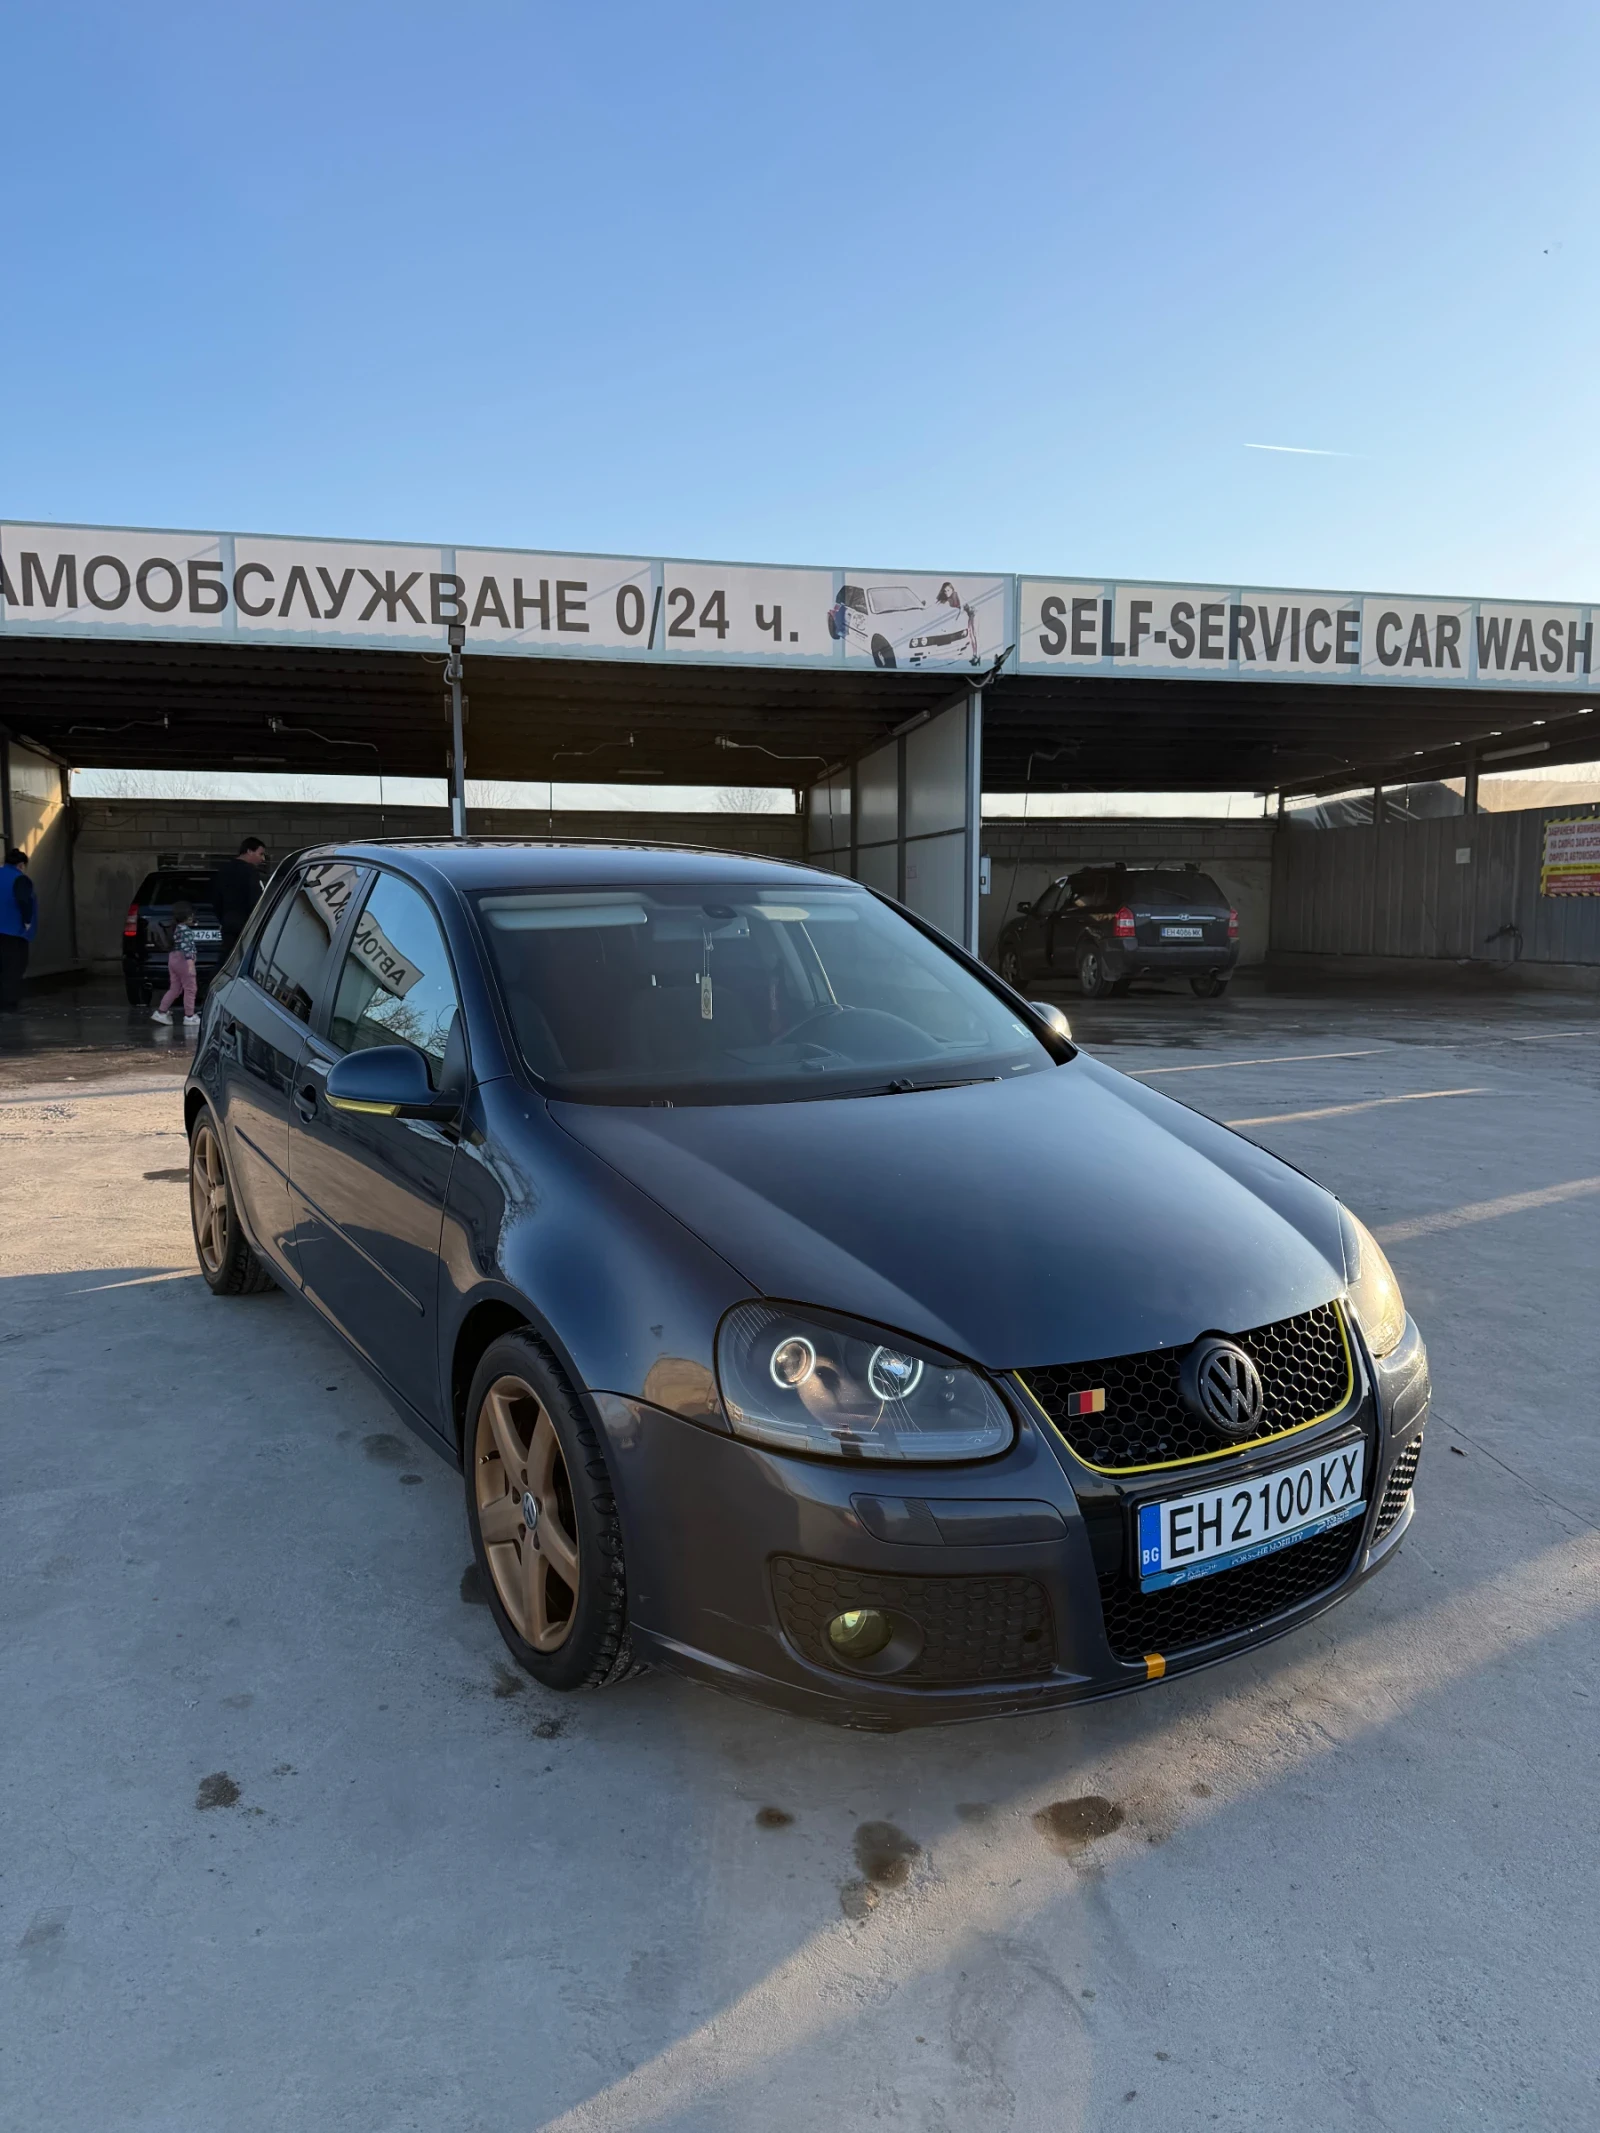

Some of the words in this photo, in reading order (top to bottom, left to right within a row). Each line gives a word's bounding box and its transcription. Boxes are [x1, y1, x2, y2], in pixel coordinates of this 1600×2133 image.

[616, 584, 730, 650] 0/24
[755, 603, 799, 643] ч.
[1039, 596, 1361, 665] SELF-SERVICE
[1375, 611, 1462, 669] CAR
[1476, 615, 1593, 674] WASH
[1142, 1546, 1160, 1565] BG
